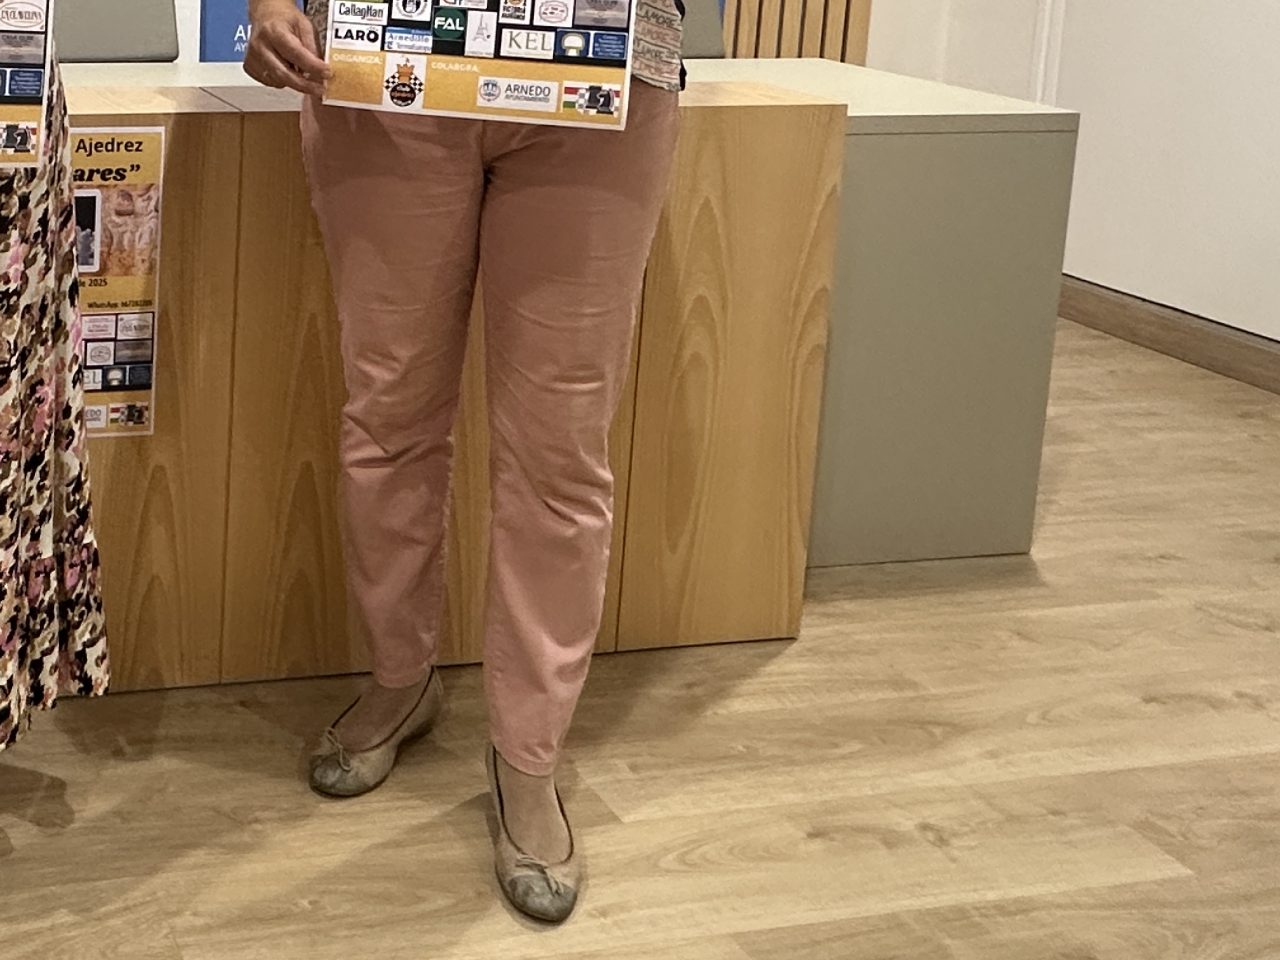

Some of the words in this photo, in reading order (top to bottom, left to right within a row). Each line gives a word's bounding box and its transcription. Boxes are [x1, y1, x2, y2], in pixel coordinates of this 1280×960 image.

[434, 16, 464, 31] FAL
[334, 27, 379, 44] LARO
[508, 30, 552, 52] KEL
[505, 83, 551, 97] ARNEDO
[75, 138, 143, 157] Ajedrez
[88, 277, 108, 288] 2025
